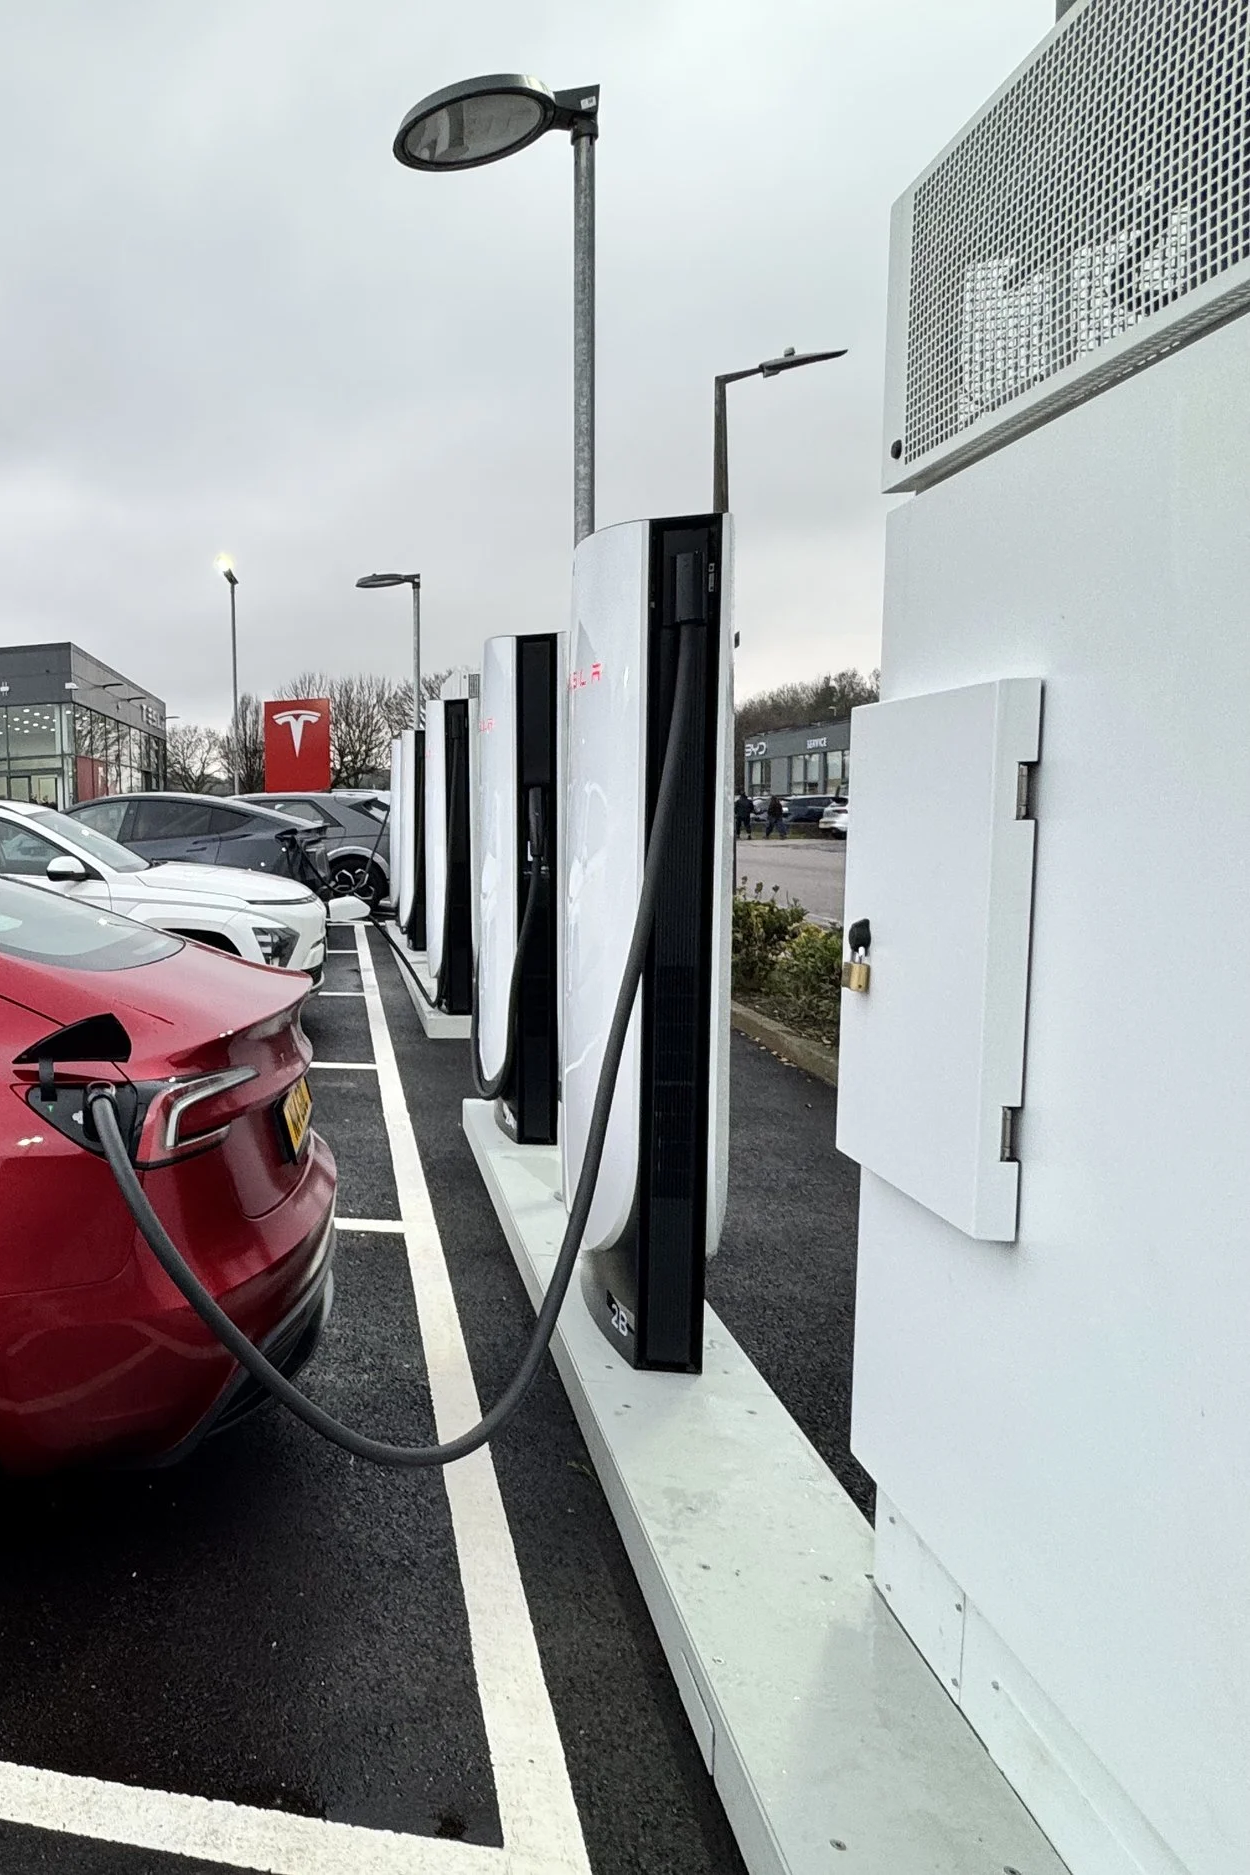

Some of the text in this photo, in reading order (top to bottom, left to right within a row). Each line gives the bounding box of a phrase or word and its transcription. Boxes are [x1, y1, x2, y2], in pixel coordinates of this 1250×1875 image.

[745, 737, 827, 756] BYD SERVICE
[611, 1303, 628, 1336] 2B
